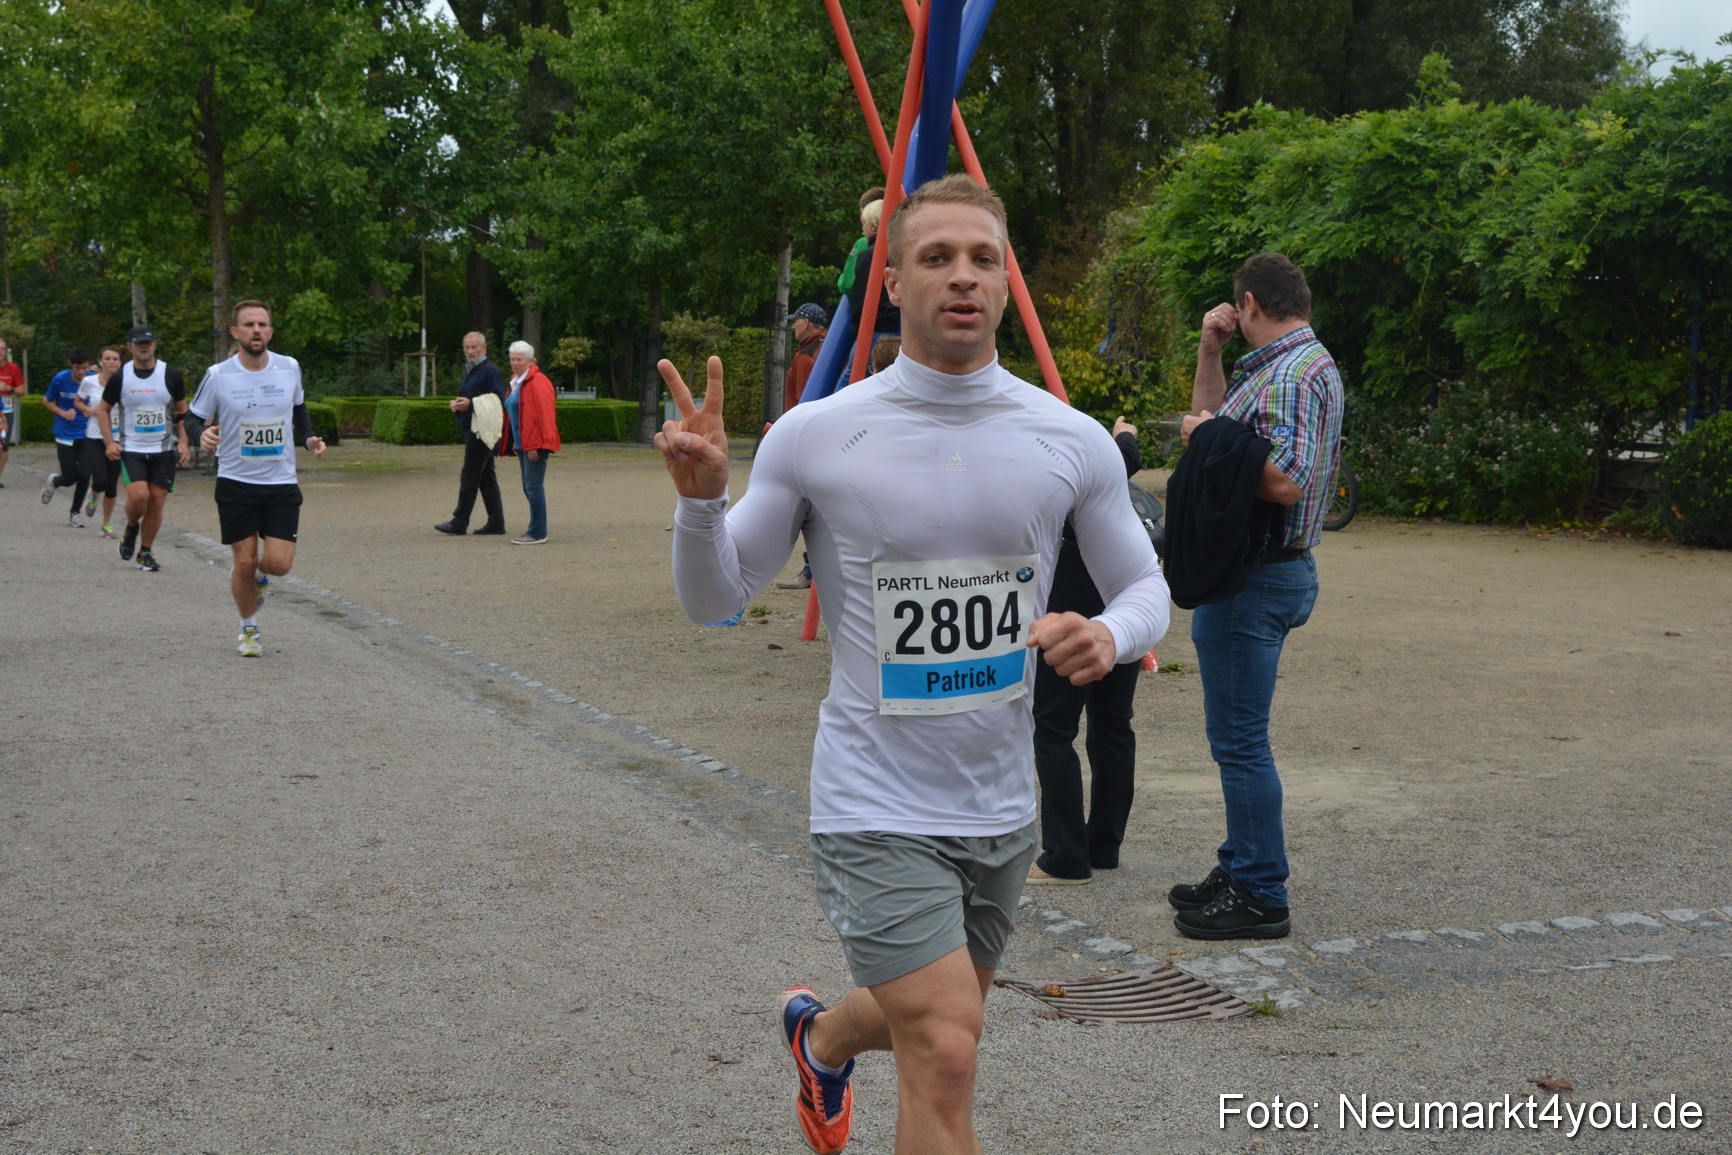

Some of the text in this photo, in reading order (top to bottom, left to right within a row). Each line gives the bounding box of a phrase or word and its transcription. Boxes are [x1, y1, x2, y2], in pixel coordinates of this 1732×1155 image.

[136, 412, 163, 425] 2378
[244, 427, 283, 445] 2404
[877, 570, 1010, 592] PARTL Neumarkt
[893, 590, 1022, 655] 2804
[926, 665, 997, 693] Patrick
